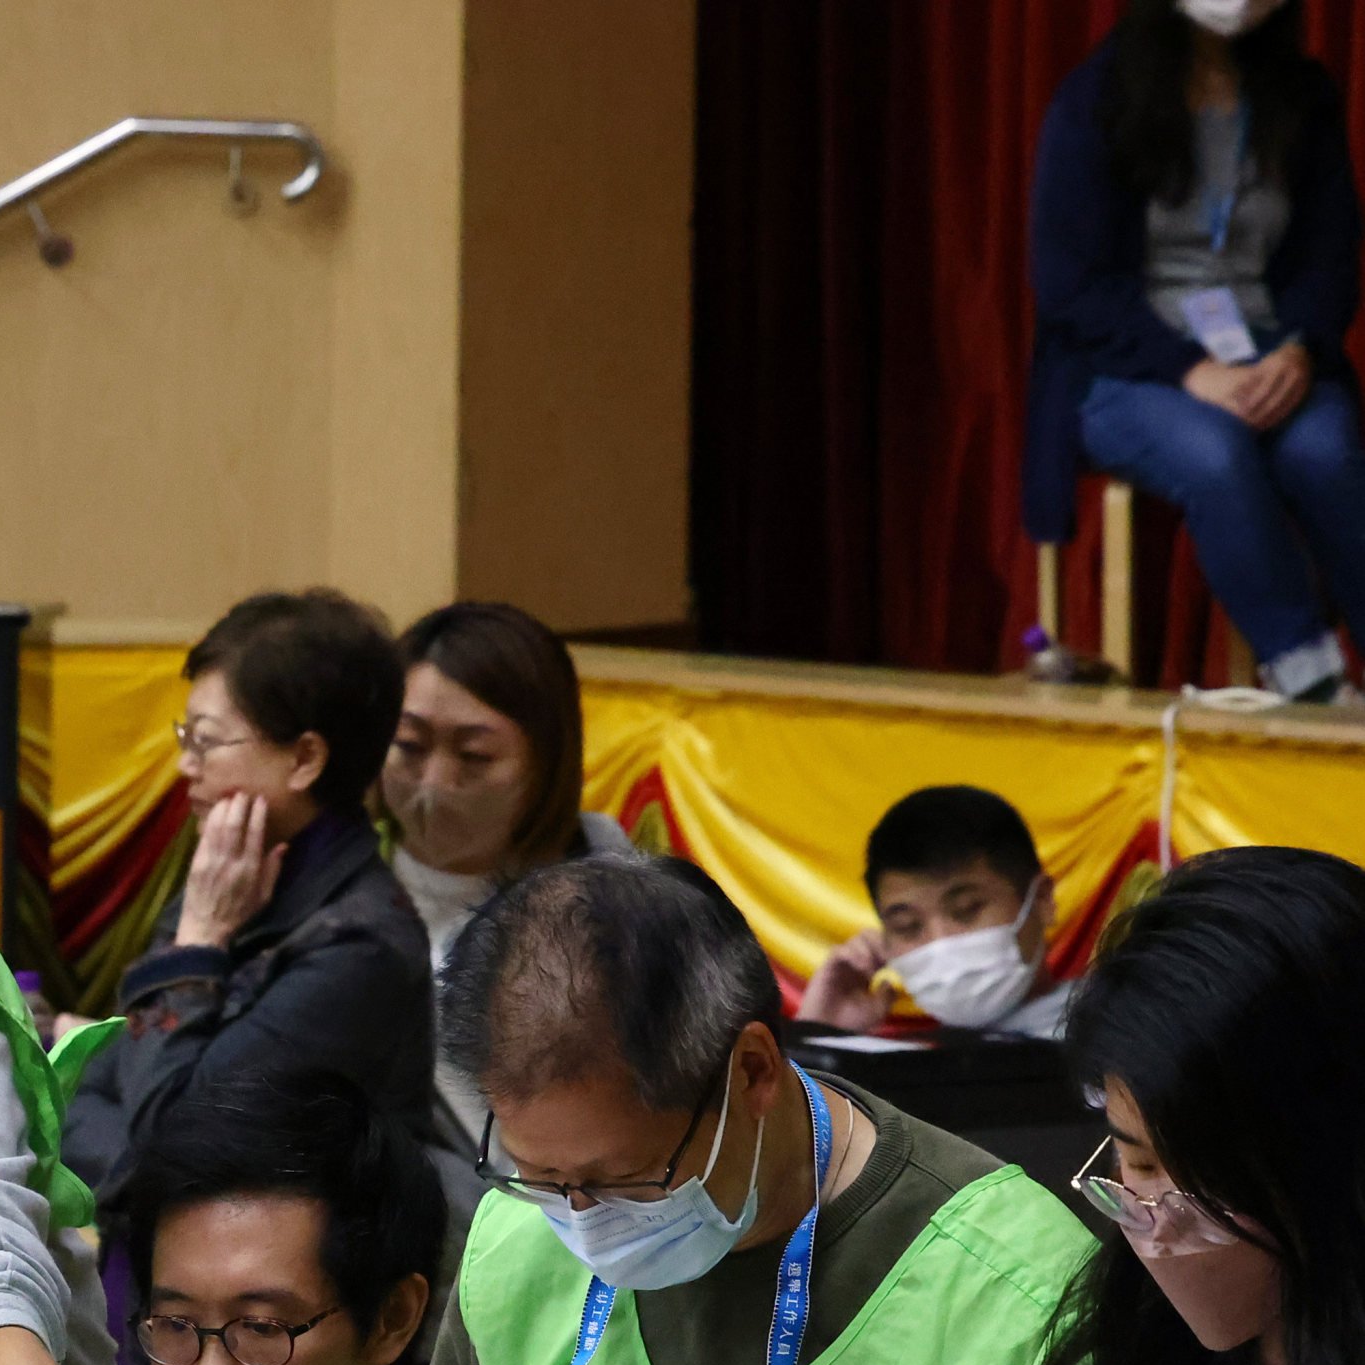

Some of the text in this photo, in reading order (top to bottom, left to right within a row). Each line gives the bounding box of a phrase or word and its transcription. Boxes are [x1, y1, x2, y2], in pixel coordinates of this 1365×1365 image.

[776, 1261, 802, 1356] 選舉工作人員
